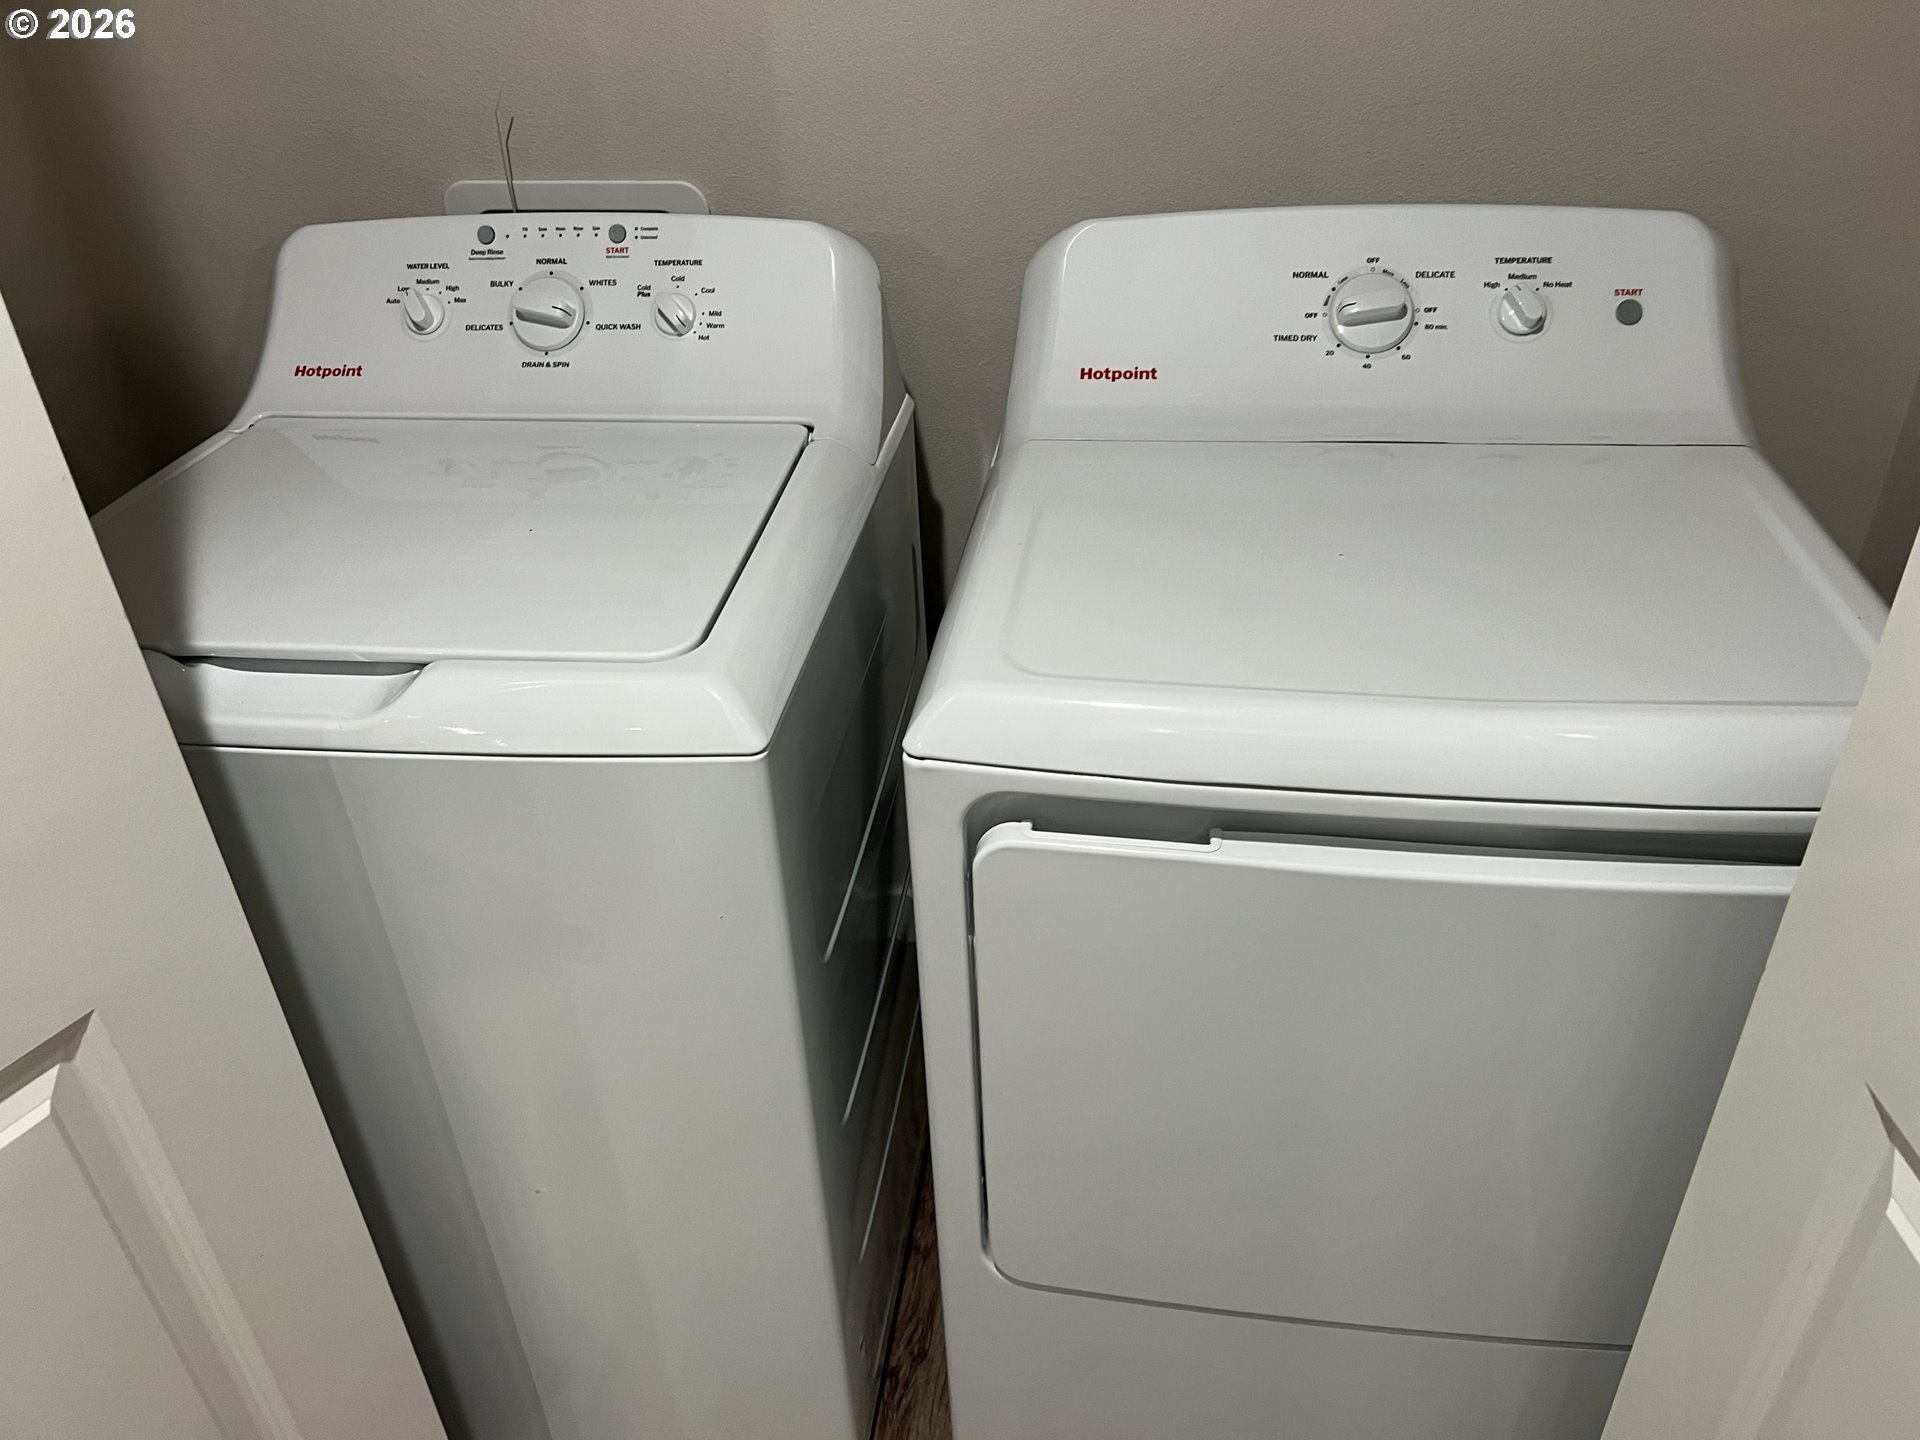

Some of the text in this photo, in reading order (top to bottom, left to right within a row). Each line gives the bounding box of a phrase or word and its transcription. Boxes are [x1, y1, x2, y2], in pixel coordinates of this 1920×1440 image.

[470, 248, 504, 256] Deep Rinse
[605, 246, 630, 255] START
[535, 257, 568, 265] NORMAL
[653, 259, 703, 267] TEMPERATURE
[1366, 256, 1381, 264] OFF
[1494, 256, 1553, 265] TEMPERATURE
[406, 262, 450, 270] WATER LEVEL
[670, 274, 686, 282] Cold
[1292, 270, 1329, 279] NORMAL
[1415, 270, 1456, 279] DELICATE
[1507, 272, 1538, 280] Medium
[489, 280, 514, 288] BULKY
[588, 278, 618, 287] WHITES
[1483, 280, 1501, 290] High
[1542, 280, 1574, 289] No Heat
[445, 284, 460, 293] High
[636, 284, 652, 292] Cold
[700, 286, 716, 294] Cool
[636, 290, 651, 298] Plus
[1613, 288, 1644, 297] START
[385, 297, 401, 305] Auto
[453, 296, 467, 304] Max
[1423, 306, 1438, 314] OFF
[465, 323, 504, 332] DELICATES
[595, 323, 642, 331] QUICK WASH
[1273, 334, 1318, 342] TIMED DRY
[1325, 349, 1335, 357] 20
[1401, 353, 1412, 361] 60
[521, 361, 545, 369] DRAIN
[294, 363, 363, 380] Hotpoint
[1079, 366, 1158, 383] Hotpoint
